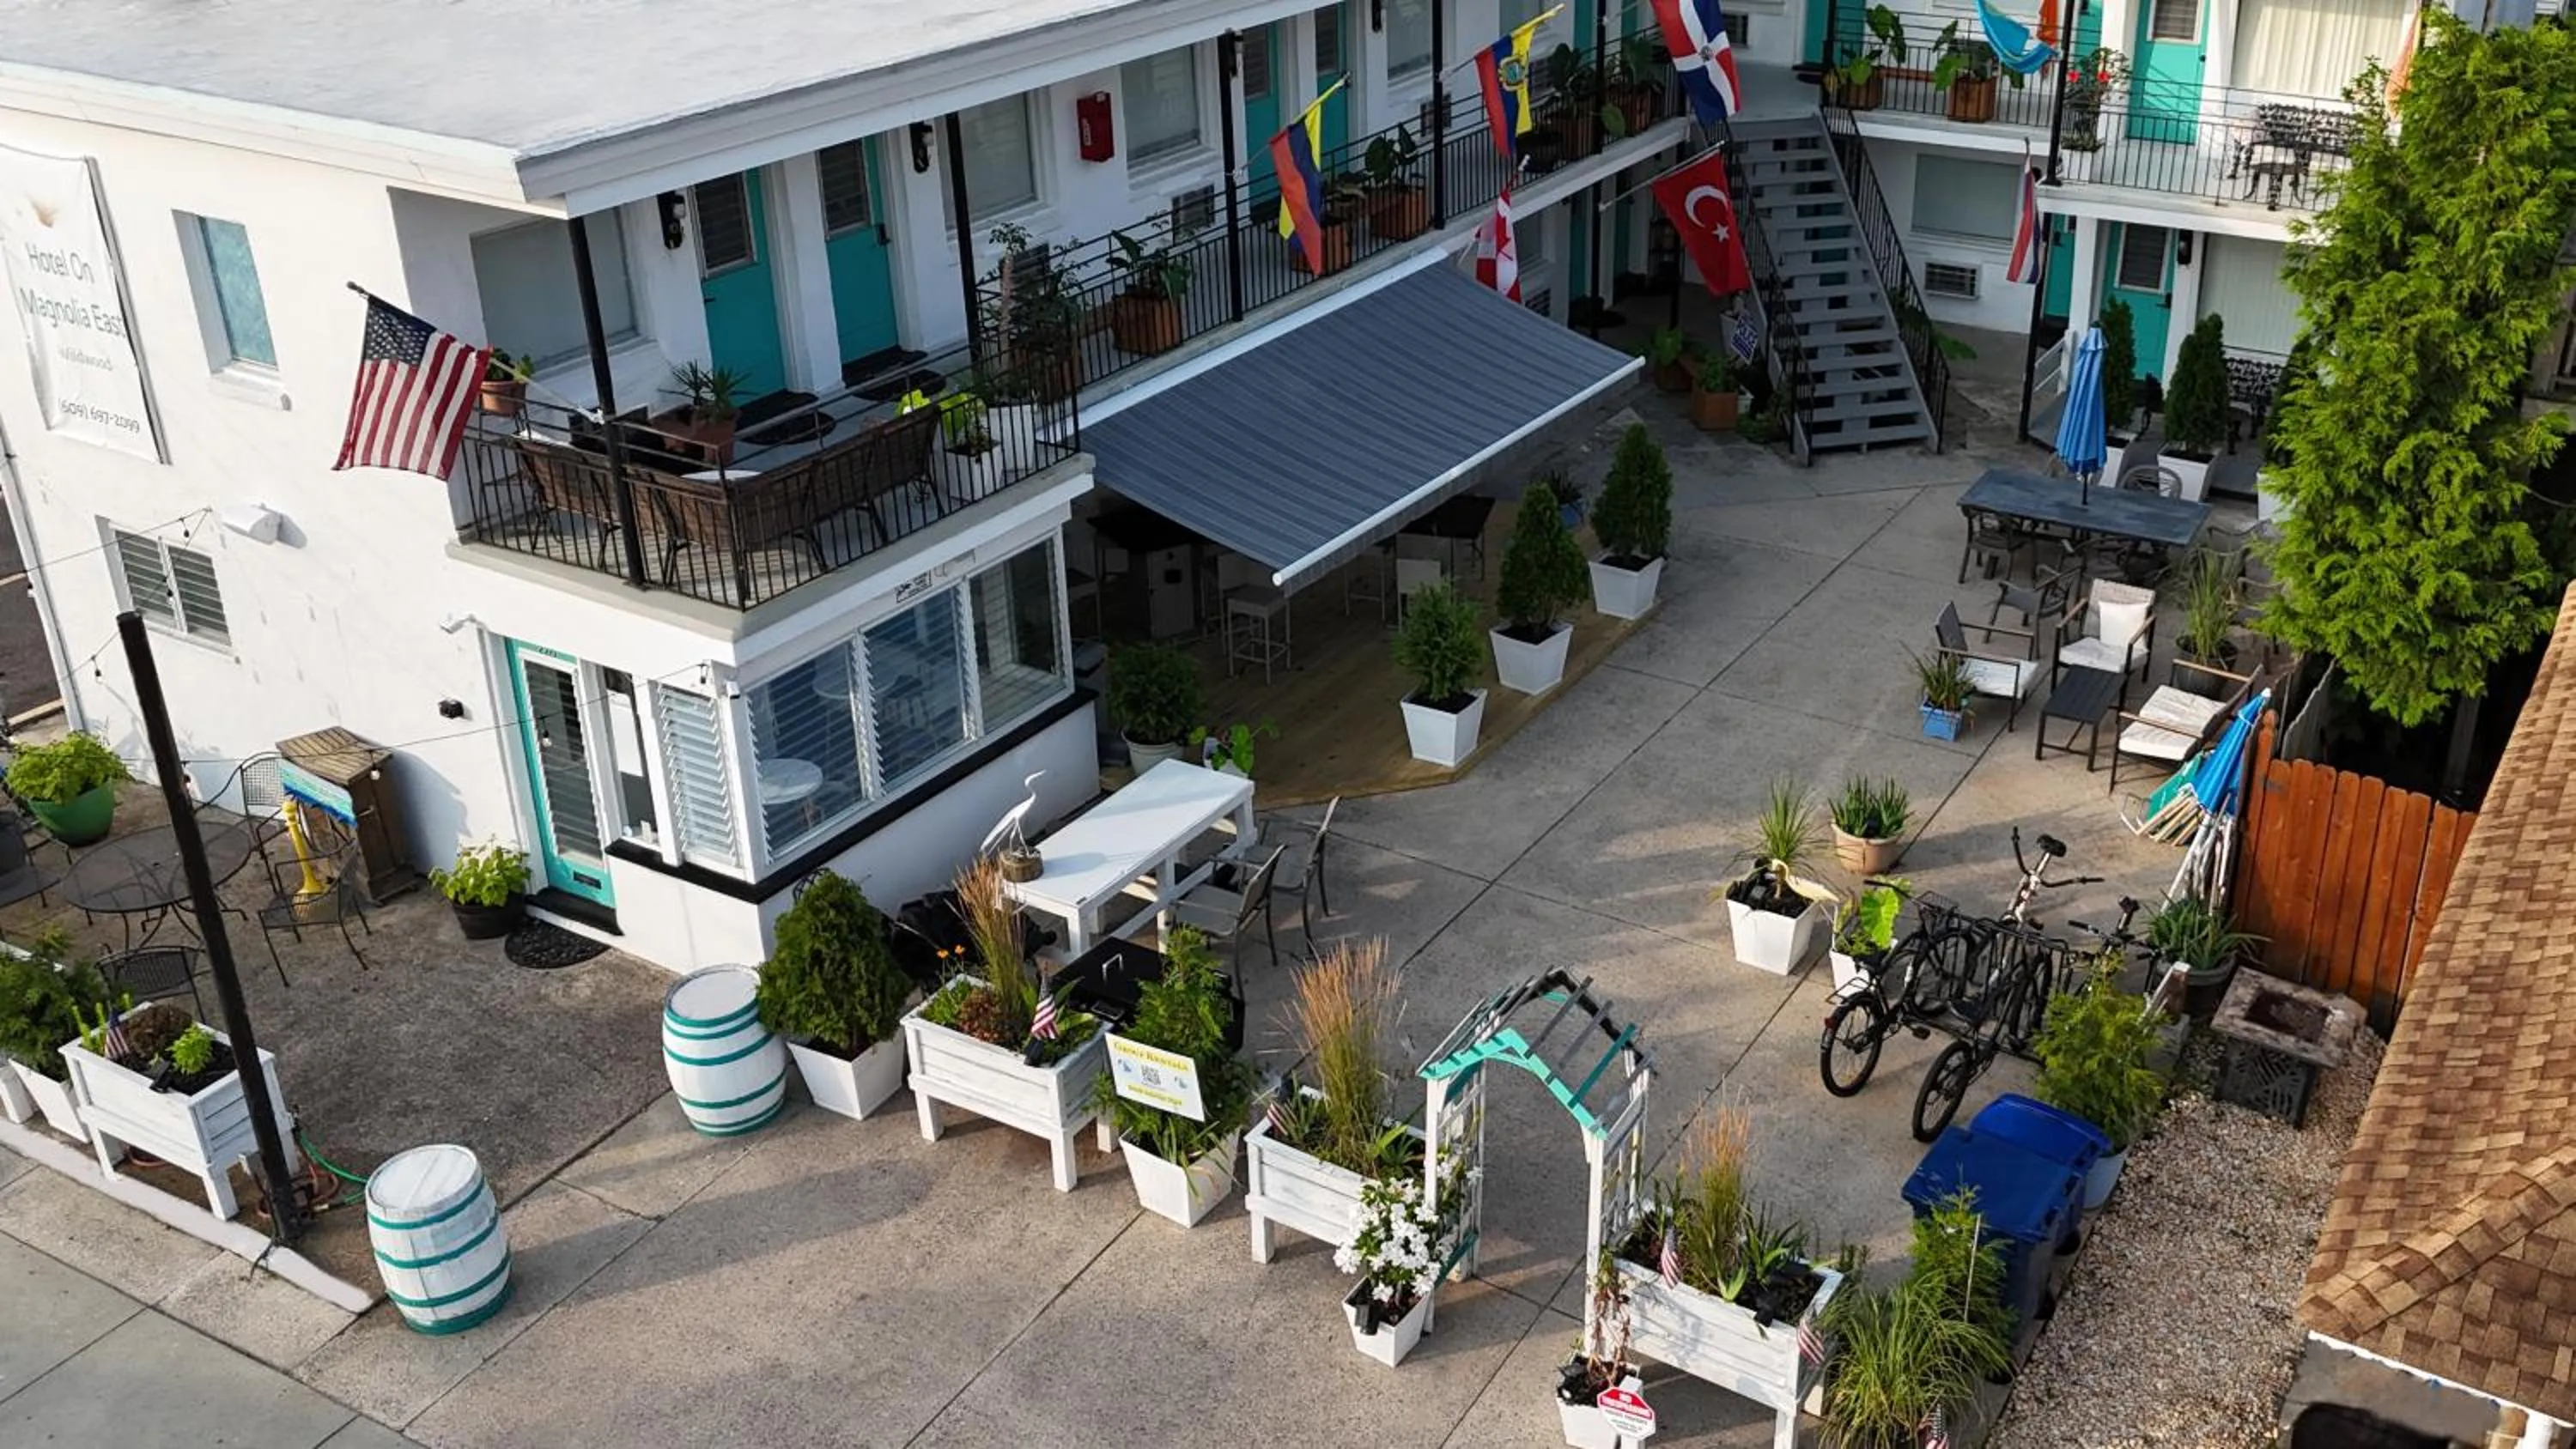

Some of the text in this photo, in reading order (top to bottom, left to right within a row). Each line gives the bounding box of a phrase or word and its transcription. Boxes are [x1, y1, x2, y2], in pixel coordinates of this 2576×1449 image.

[25, 241, 95, 284] Hotel On
[20, 287, 91, 328] Magnolia
